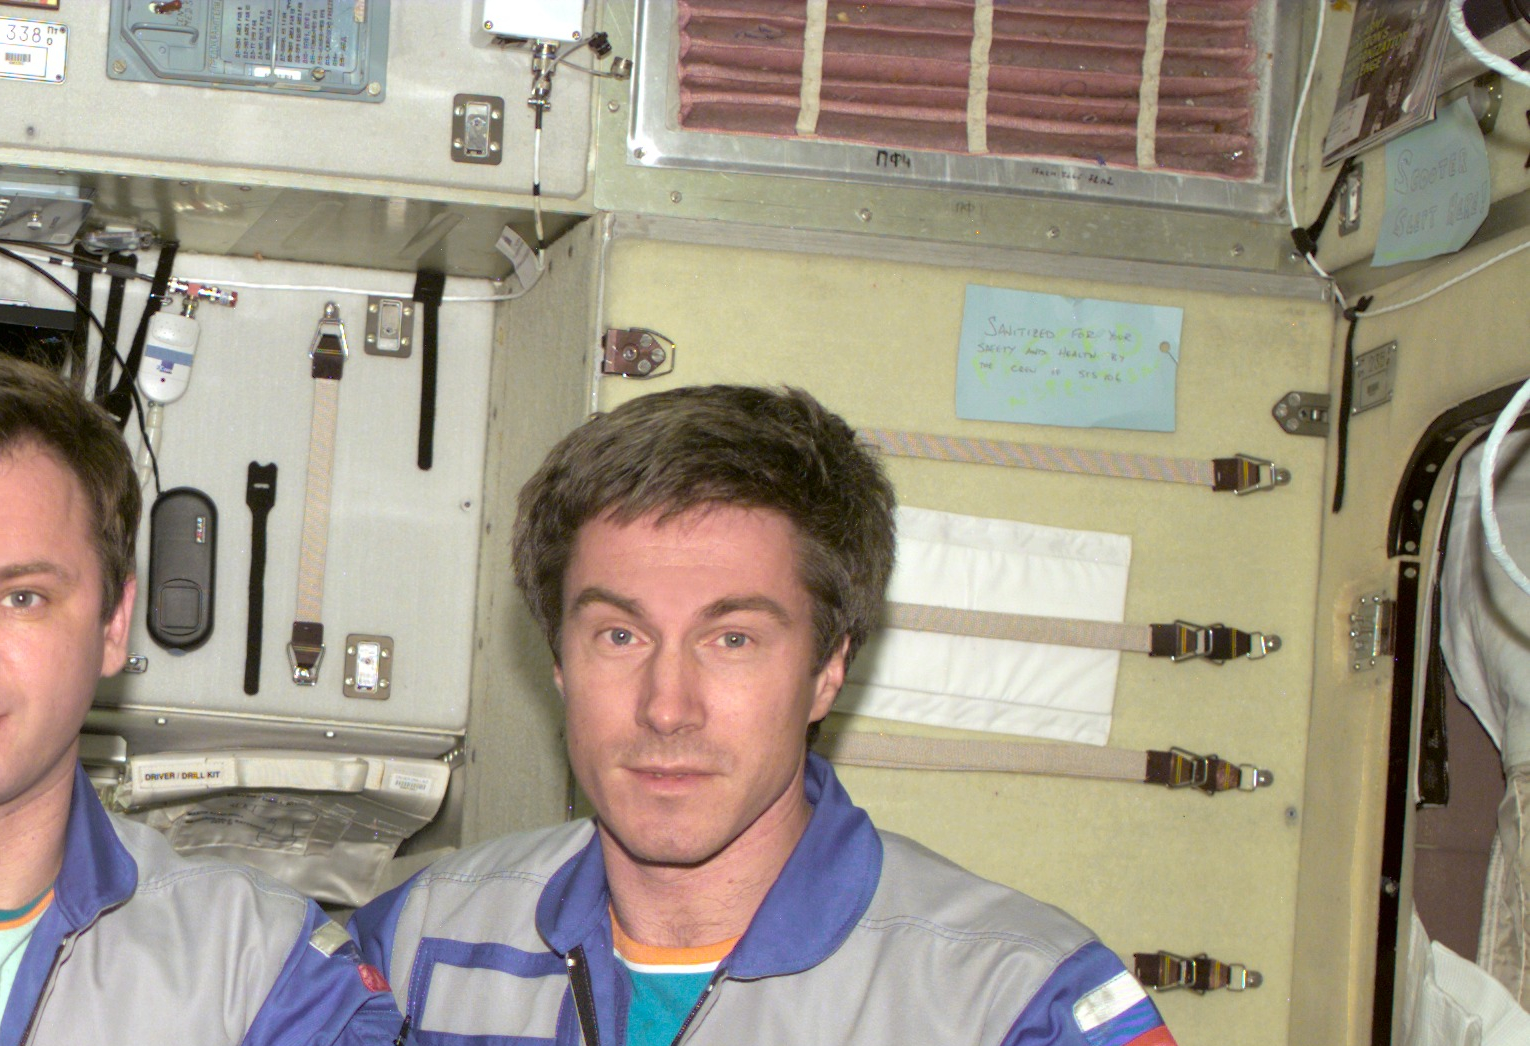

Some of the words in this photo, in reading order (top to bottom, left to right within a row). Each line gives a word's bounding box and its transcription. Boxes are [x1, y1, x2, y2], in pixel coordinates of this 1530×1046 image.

[6, 24, 41, 43] 338
[1394, 148, 1468, 194] SCOOTER
[984, 316, 1055, 338] SANITIZED
[1071, 329, 1096, 339] FOR
[1025, 347, 1047, 356] AND
[145, 771, 175, 781] DRIVER
[182, 770, 205, 780] DRILL
[206, 770, 221, 779] KIT
